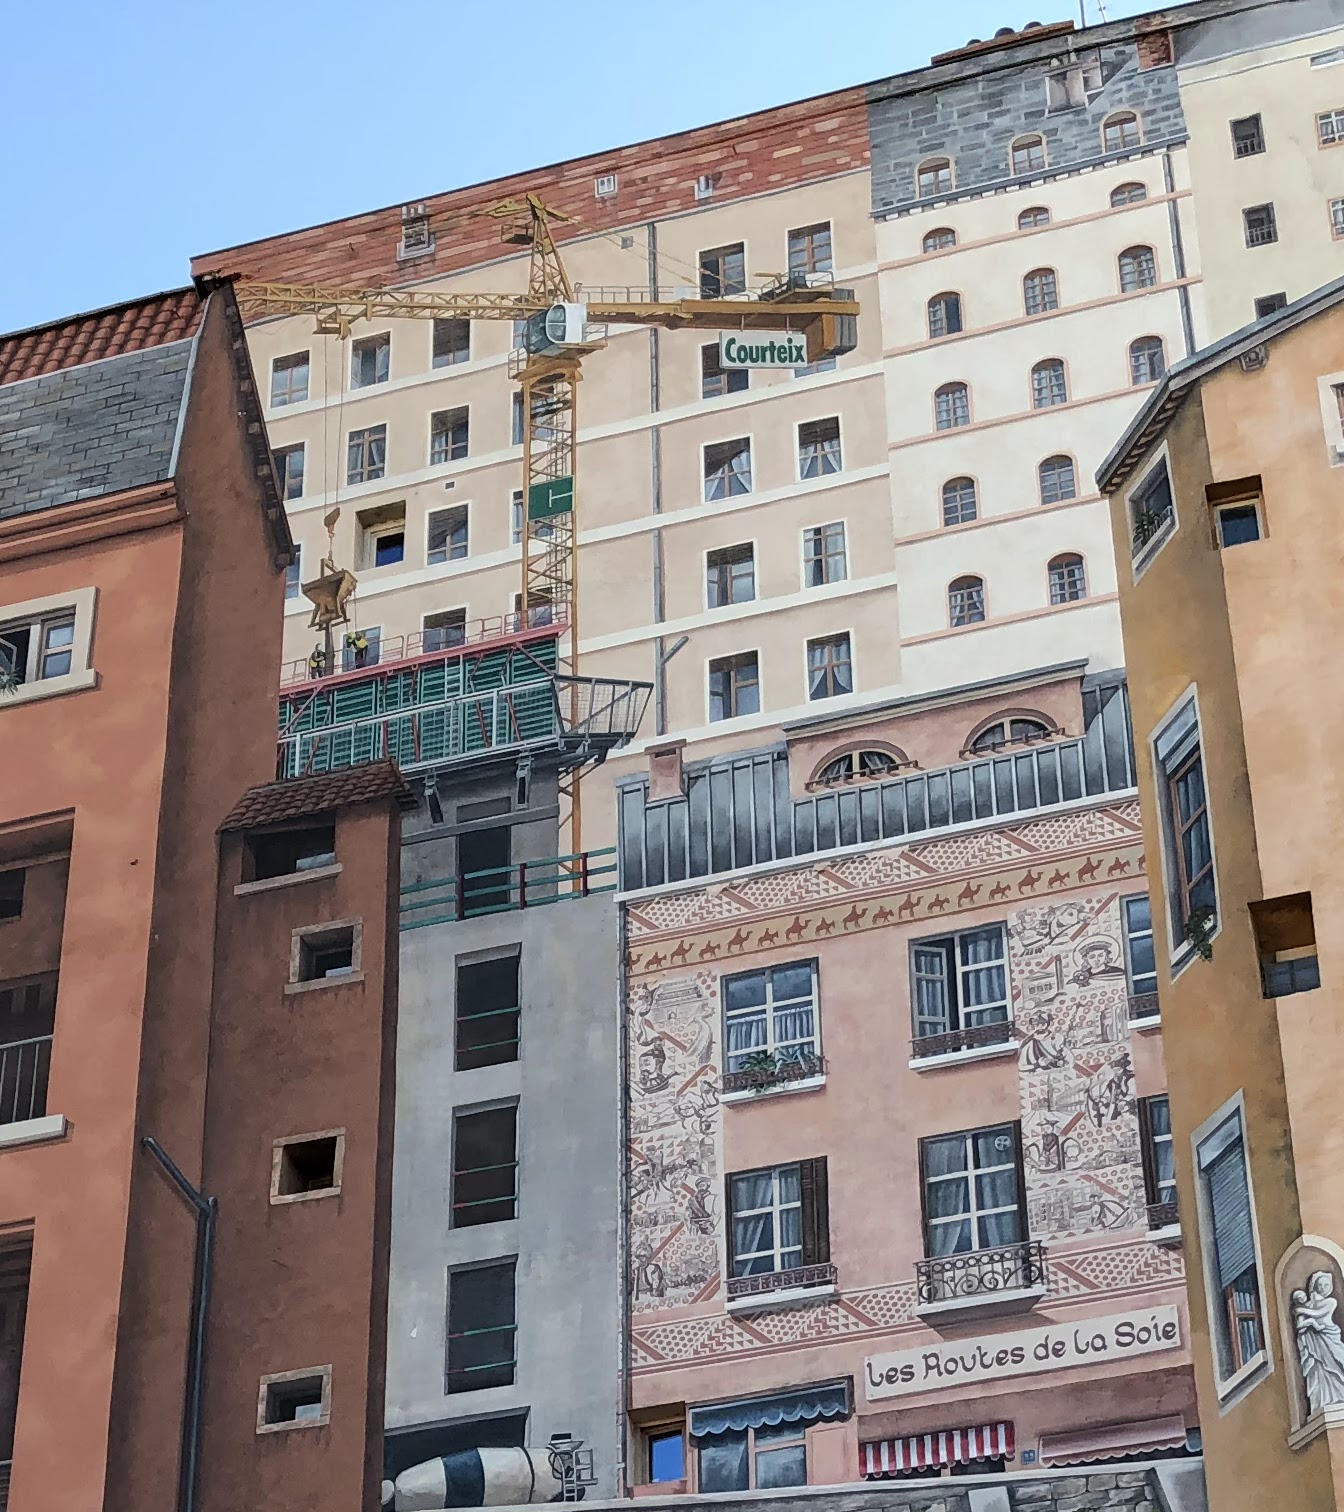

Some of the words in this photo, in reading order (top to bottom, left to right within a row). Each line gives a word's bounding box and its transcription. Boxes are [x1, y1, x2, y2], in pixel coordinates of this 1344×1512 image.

[724, 337, 806, 364] Courteix
[866, 1361, 916, 1388] Les
[922, 1345, 1026, 1381] Routes
[1033, 1335, 1066, 1362] de
[1114, 1315, 1177, 1349] Soie
